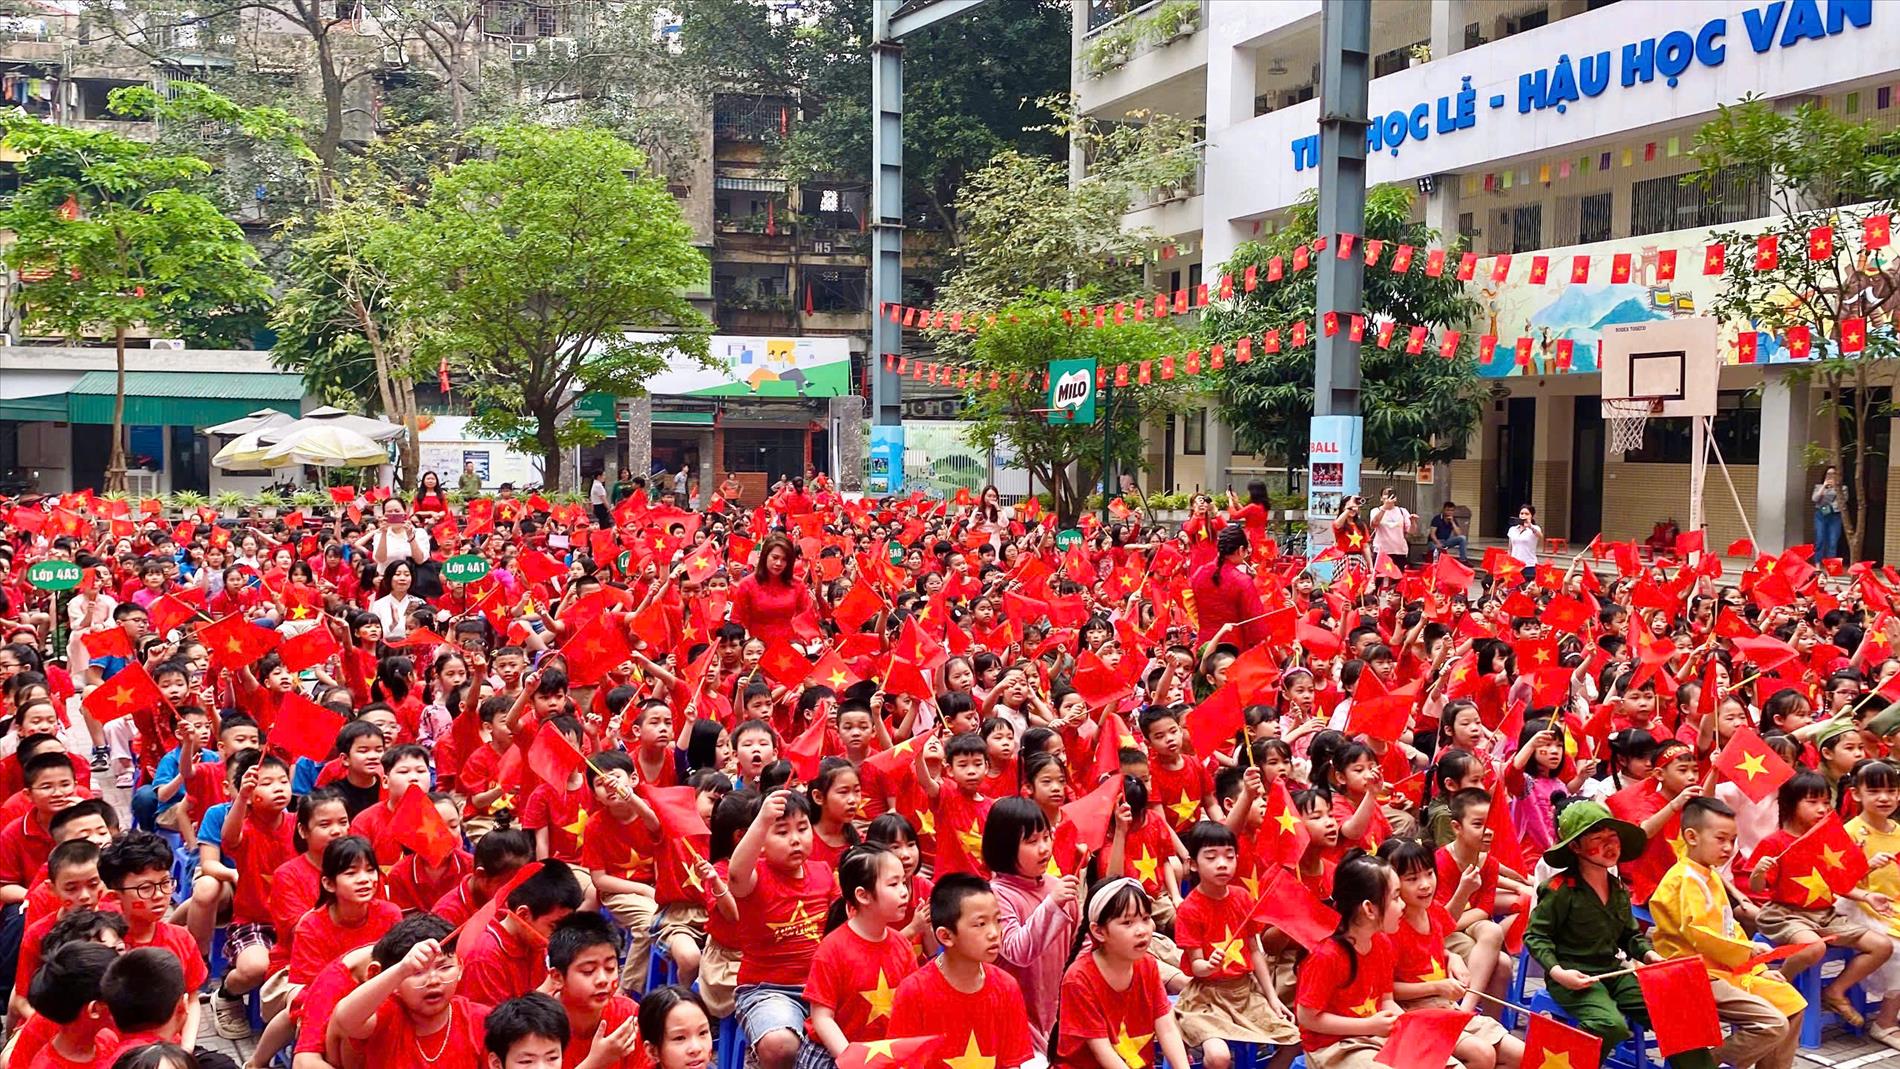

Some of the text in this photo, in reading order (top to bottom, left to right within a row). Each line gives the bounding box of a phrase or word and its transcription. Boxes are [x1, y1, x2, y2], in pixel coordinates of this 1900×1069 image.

[1518, 54, 1610, 113] HẬU
[1621, 20, 1727, 88] HỌC
[814, 242, 831, 253] H5
[1058, 381, 1087, 402] MILO
[32, 568, 78, 582] Lớp 4A3
[446, 562, 485, 574] Lớp 4A1
